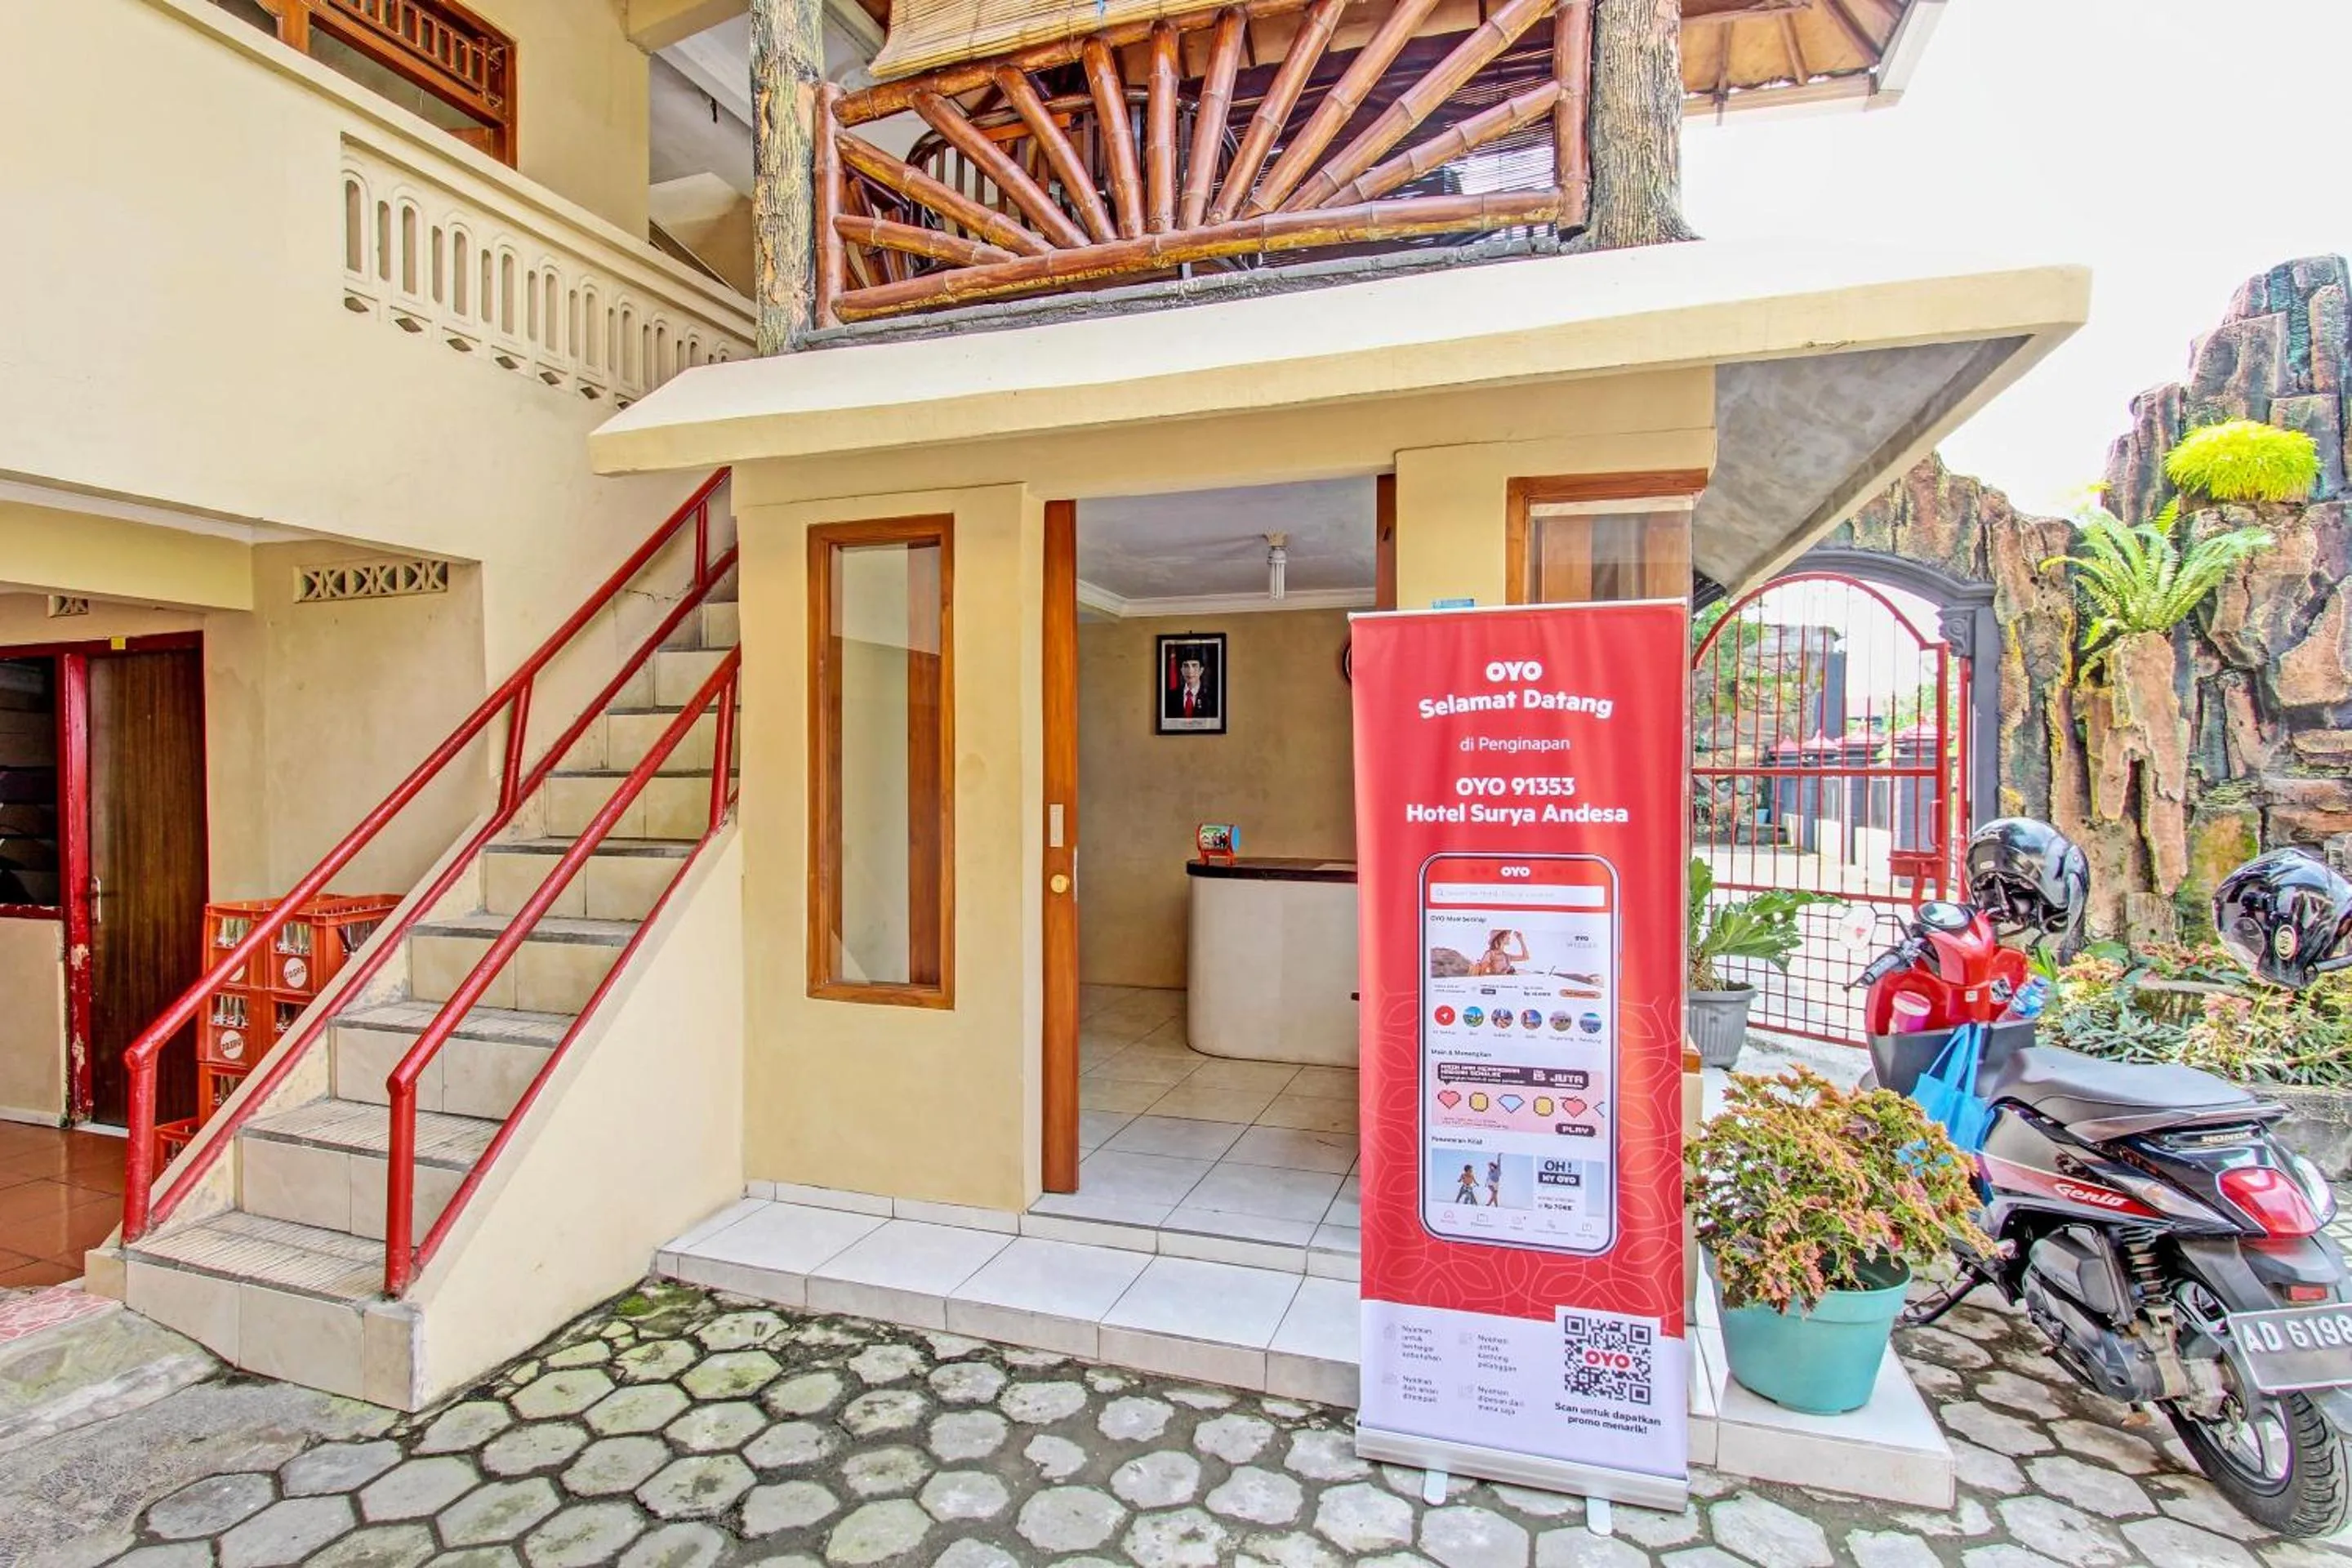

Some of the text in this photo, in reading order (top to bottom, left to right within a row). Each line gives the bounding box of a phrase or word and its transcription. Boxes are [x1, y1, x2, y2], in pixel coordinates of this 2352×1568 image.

[1486, 662, 1542, 682] OYO
[1419, 689, 1613, 719] Selamat Datang
[1459, 737, 1570, 752] di Penginapan
[1455, 777, 1575, 796] OYO 91353
[1406, 804, 1628, 826] Hotel Surya Andesa
[1500, 866, 1530, 877] OYO
[1561, 1125, 1589, 1134] PLAY
[1544, 1160, 1572, 1174] OH!
[2054, 1183, 2131, 1206] Genio
[2242, 1314, 2352, 1352] AD 6198
[1585, 1350, 1630, 1369] OYO
[1555, 1401, 1661, 1426] Scan untuk dapatkan
[1567, 1416, 1647, 1434] promo menarik!
